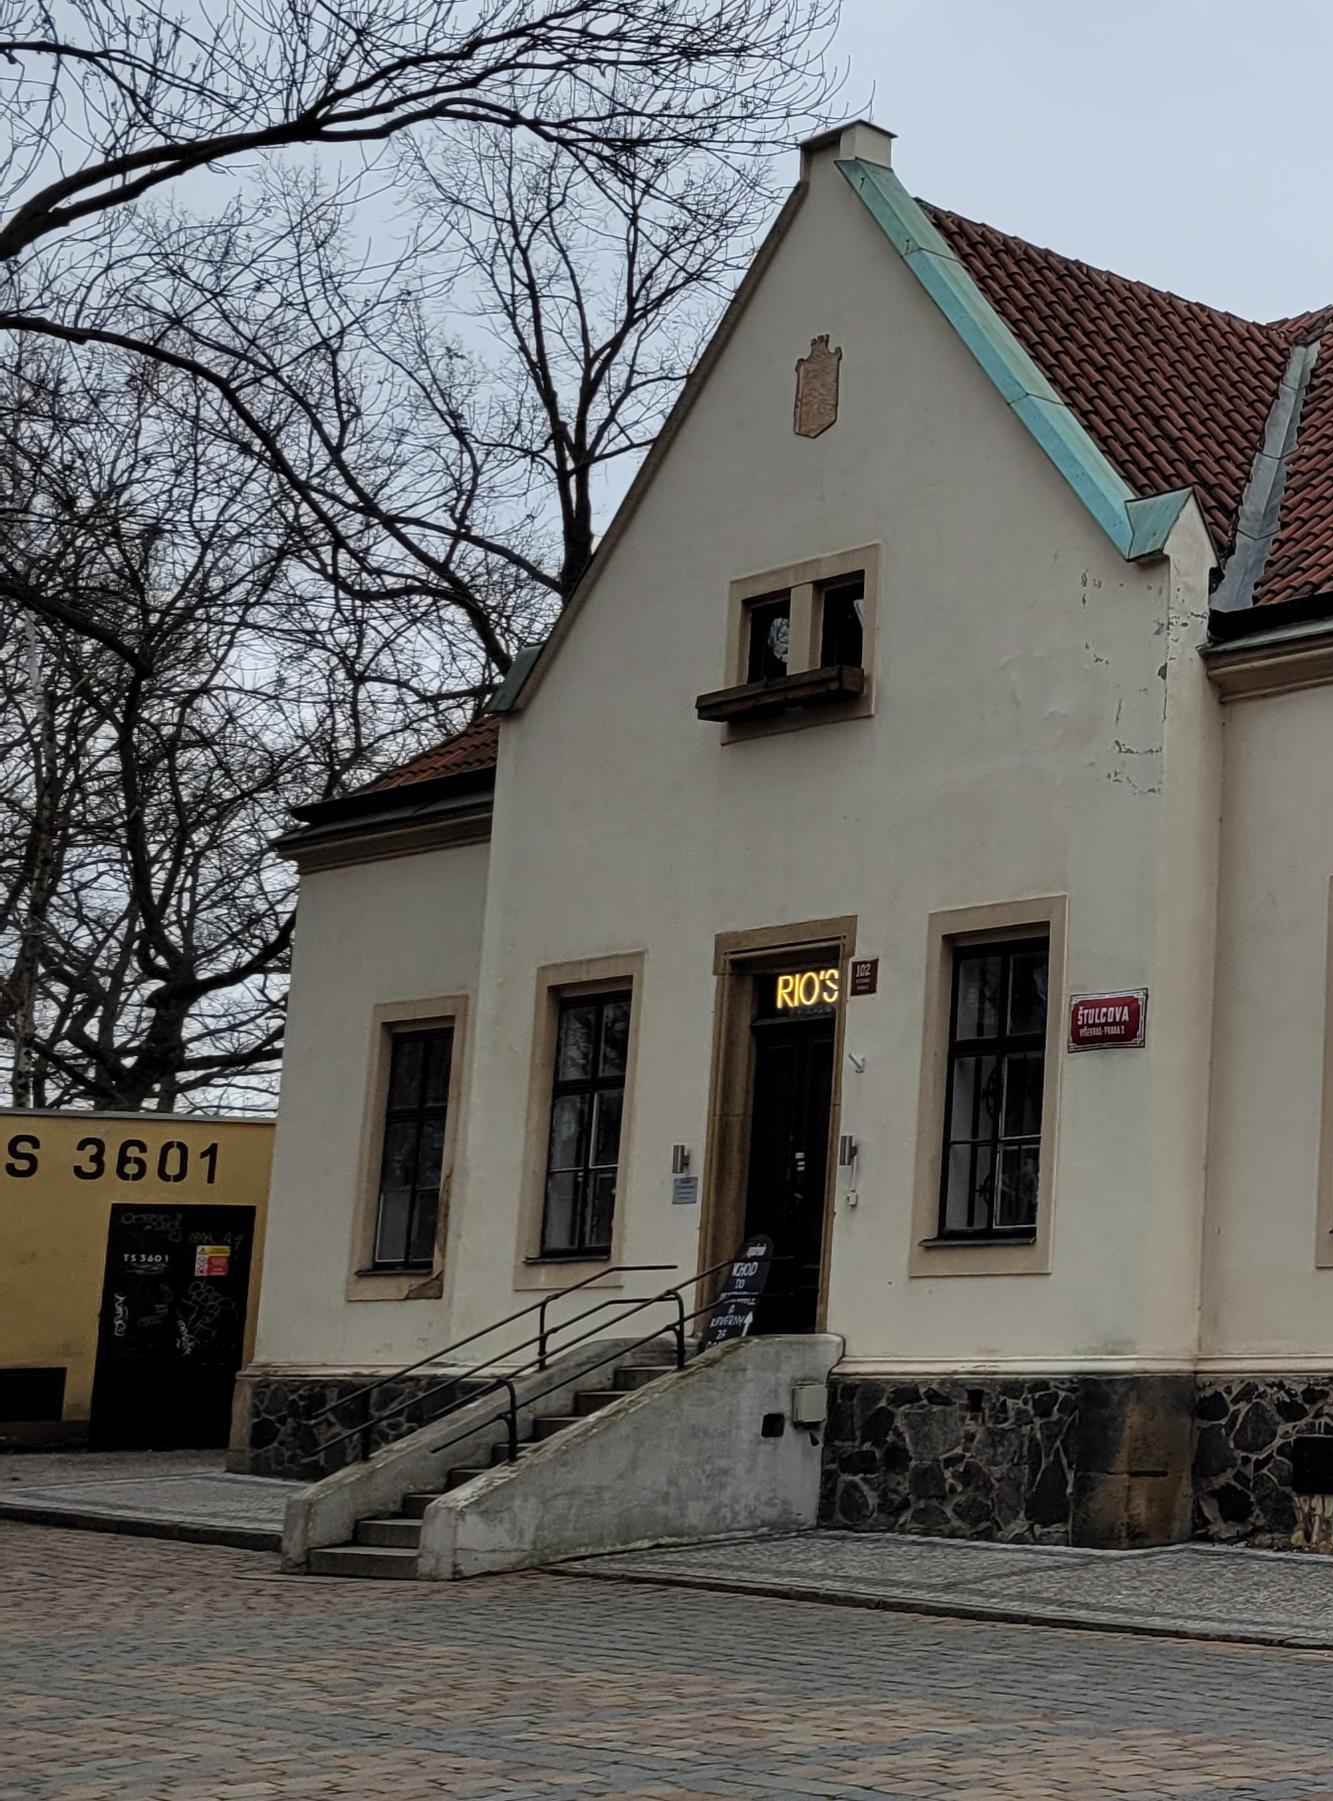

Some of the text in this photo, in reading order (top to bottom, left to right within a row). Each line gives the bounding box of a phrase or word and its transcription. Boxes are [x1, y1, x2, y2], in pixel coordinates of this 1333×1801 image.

[856, 963, 871, 978] 102
[777, 968, 840, 1009] RIO'S
[1077, 1005, 1130, 1026] ŠTULCOVA
[73, 1137, 219, 1184] 3601
[123, 1253, 169, 1263] TS 3601
